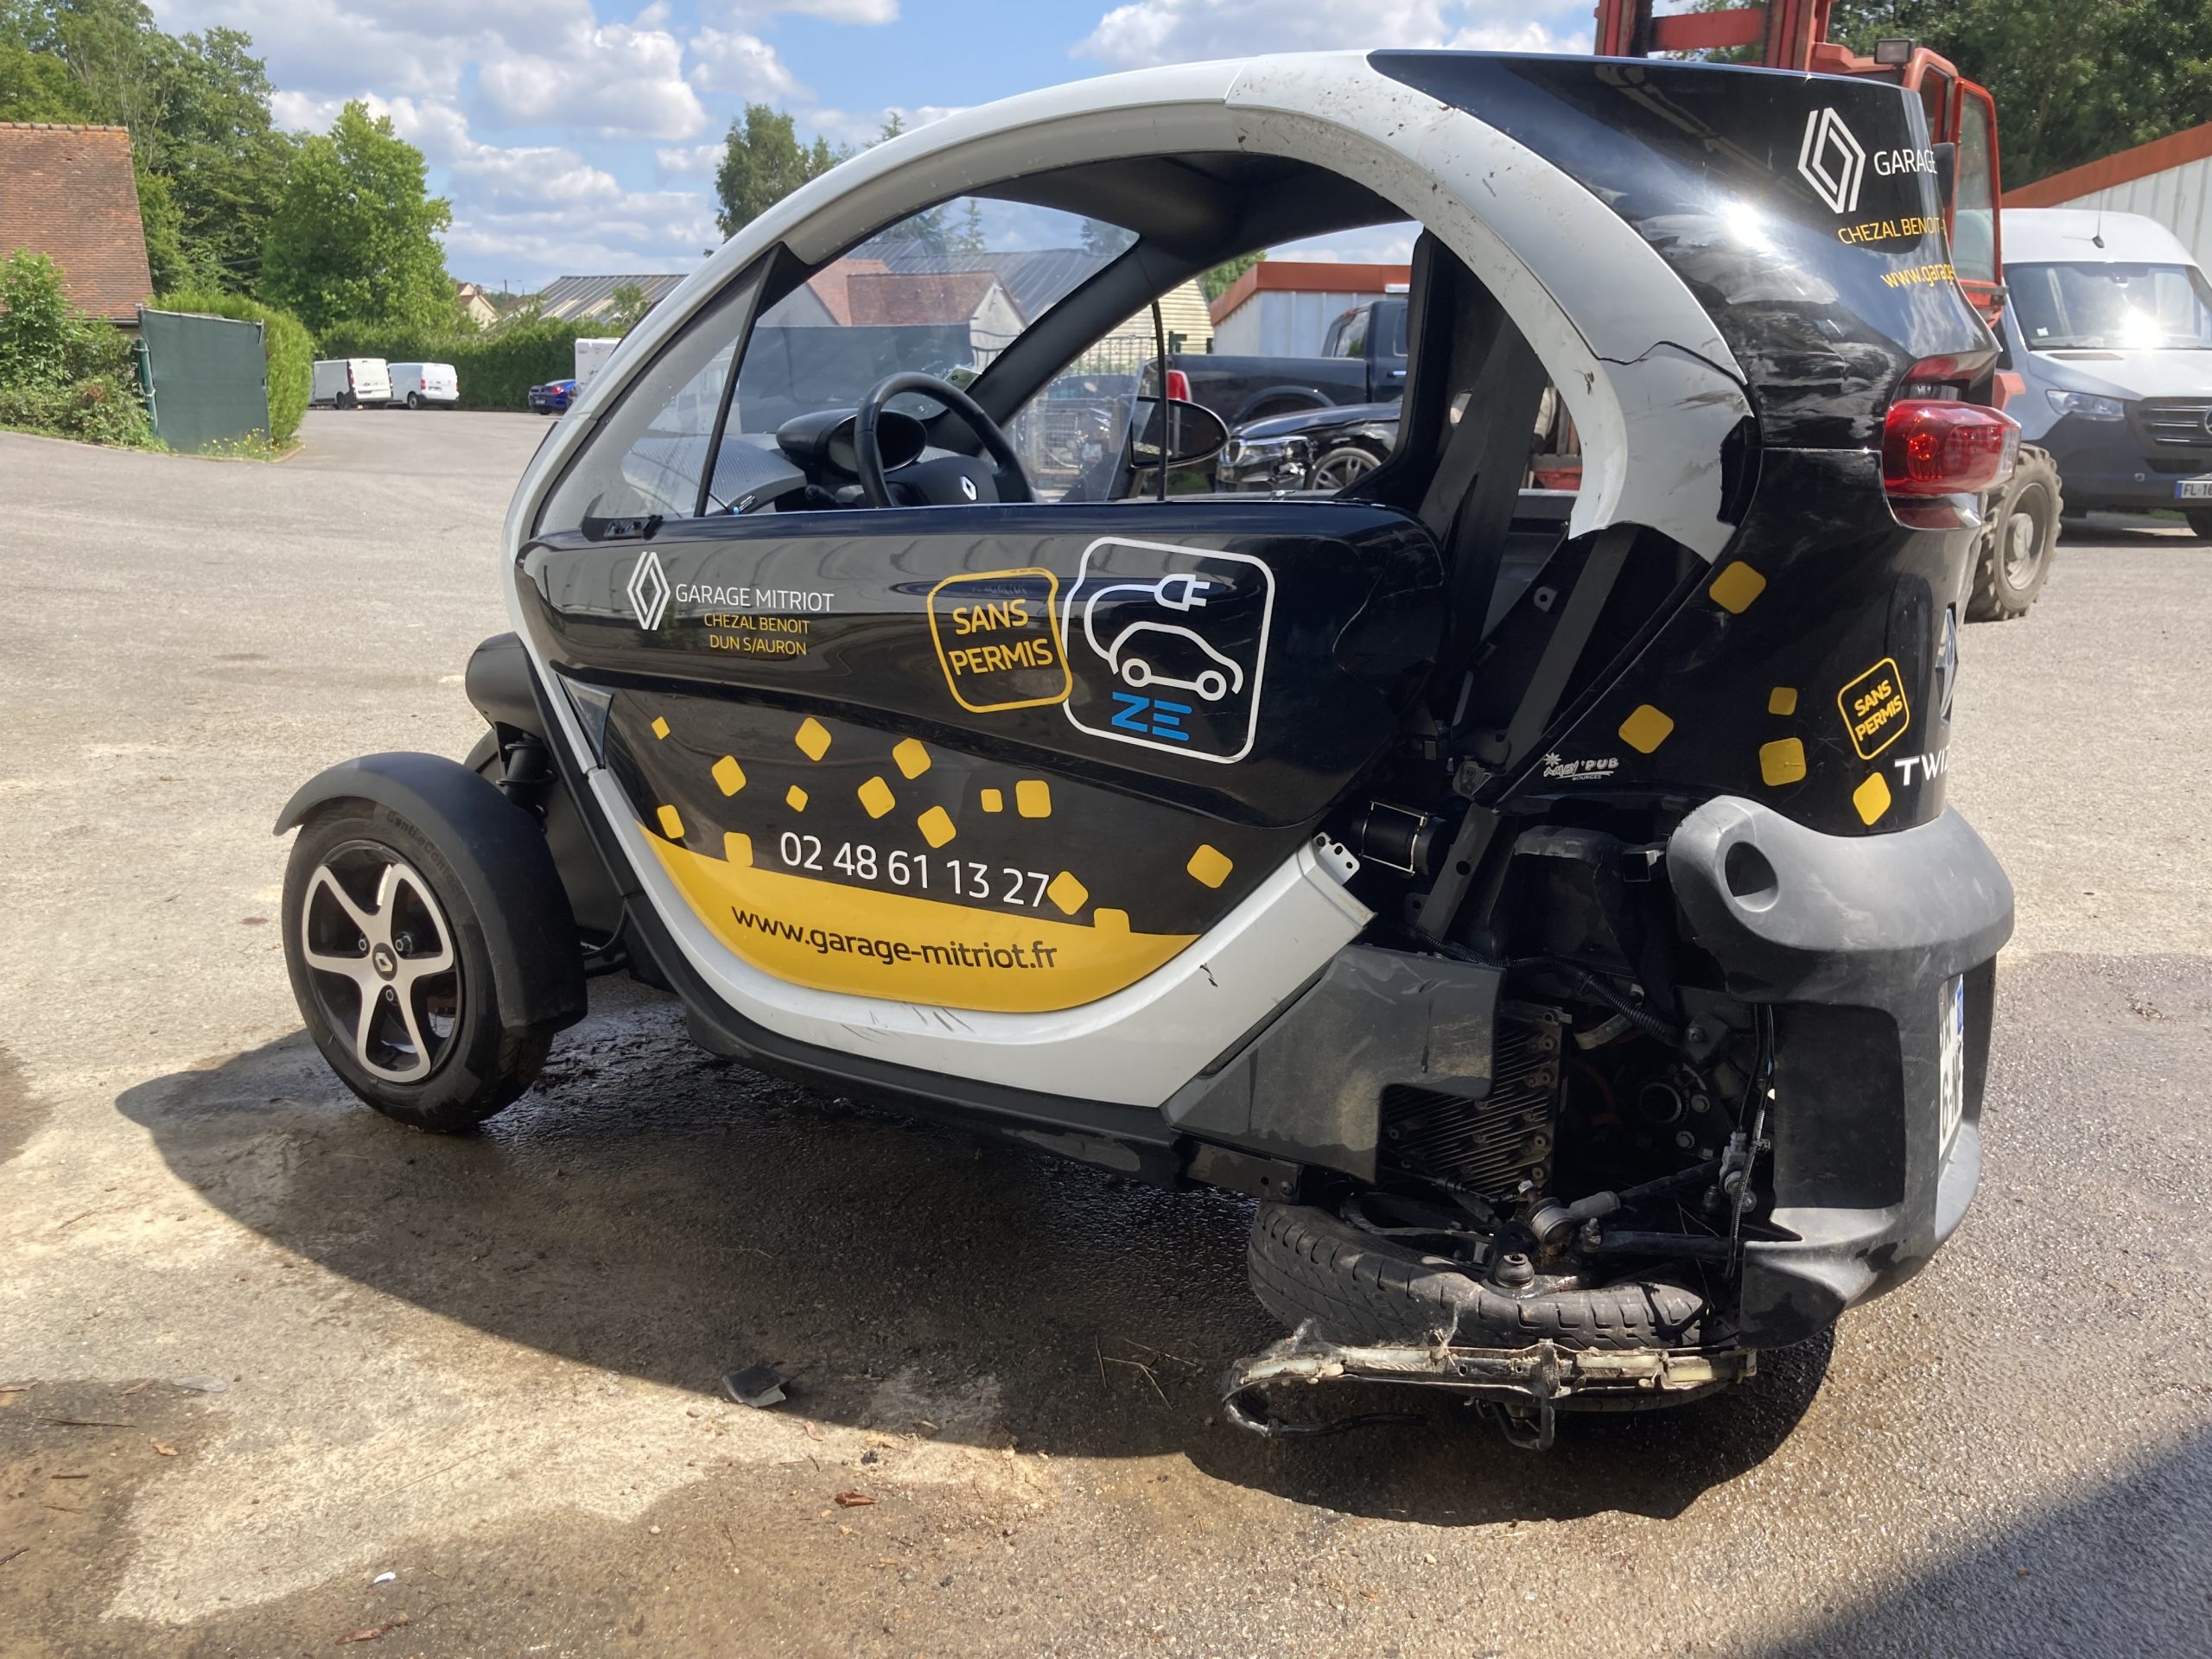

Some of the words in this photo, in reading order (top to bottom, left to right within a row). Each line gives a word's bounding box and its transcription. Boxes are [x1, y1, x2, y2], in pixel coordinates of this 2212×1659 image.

[1873, 148, 1937, 176] GARAGE
[1837, 220, 1901, 245] CHEZAL
[675, 583, 751, 607] GARAGE
[756, 589, 835, 613] MITRIOT
[952, 598, 1029, 636] SANS
[703, 613, 757, 631] CHEZAL
[759, 617, 810, 634] BENOIT
[709, 634, 740, 651] DUN
[743, 637, 807, 656] S/AURON
[949, 638, 1053, 676] PERMIS
[1854, 679, 1892, 717] SANS
[1854, 695, 1904, 741] PERMIS
[780, 831, 823, 871] 02
[832, 842, 878, 880] 48
[887, 850, 930, 889] 61
[946, 859, 990, 899] 13
[1002, 867, 1050, 907] 27
[730, 906, 1058, 969] www.garage-mitriot.fr
